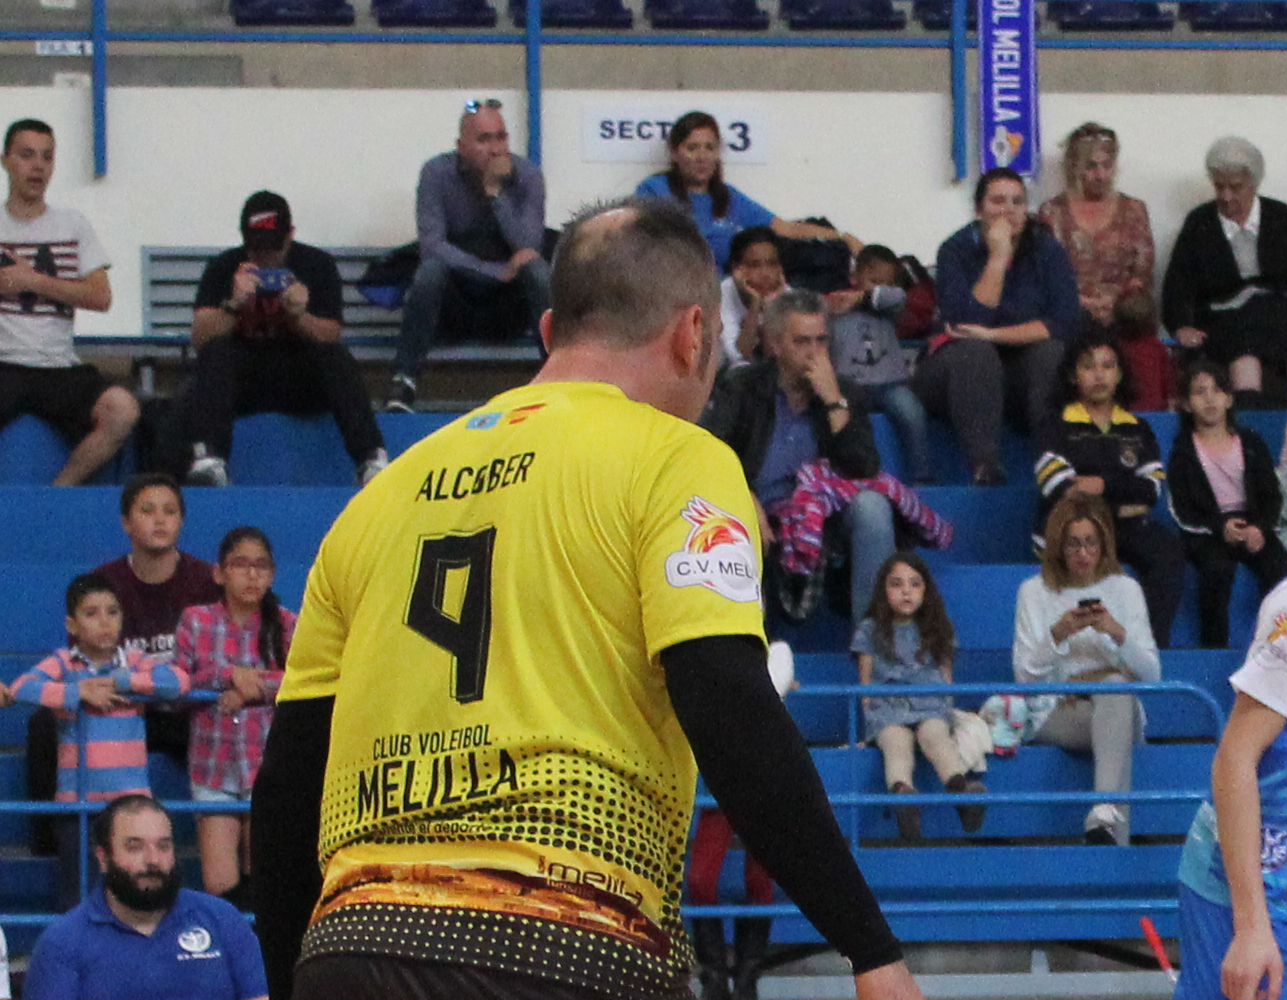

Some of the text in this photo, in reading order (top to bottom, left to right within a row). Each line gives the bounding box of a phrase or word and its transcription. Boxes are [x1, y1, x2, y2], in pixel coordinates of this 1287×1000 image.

[991, 29, 1022, 122] MELILLA
[599, 120, 751, 152] SECT 3
[676, 559, 714, 576] C.V.
[402, 524, 498, 706] 9
[372, 724, 493, 760] CLUB VOLEIBOL
[355, 748, 519, 825] MELILLA
